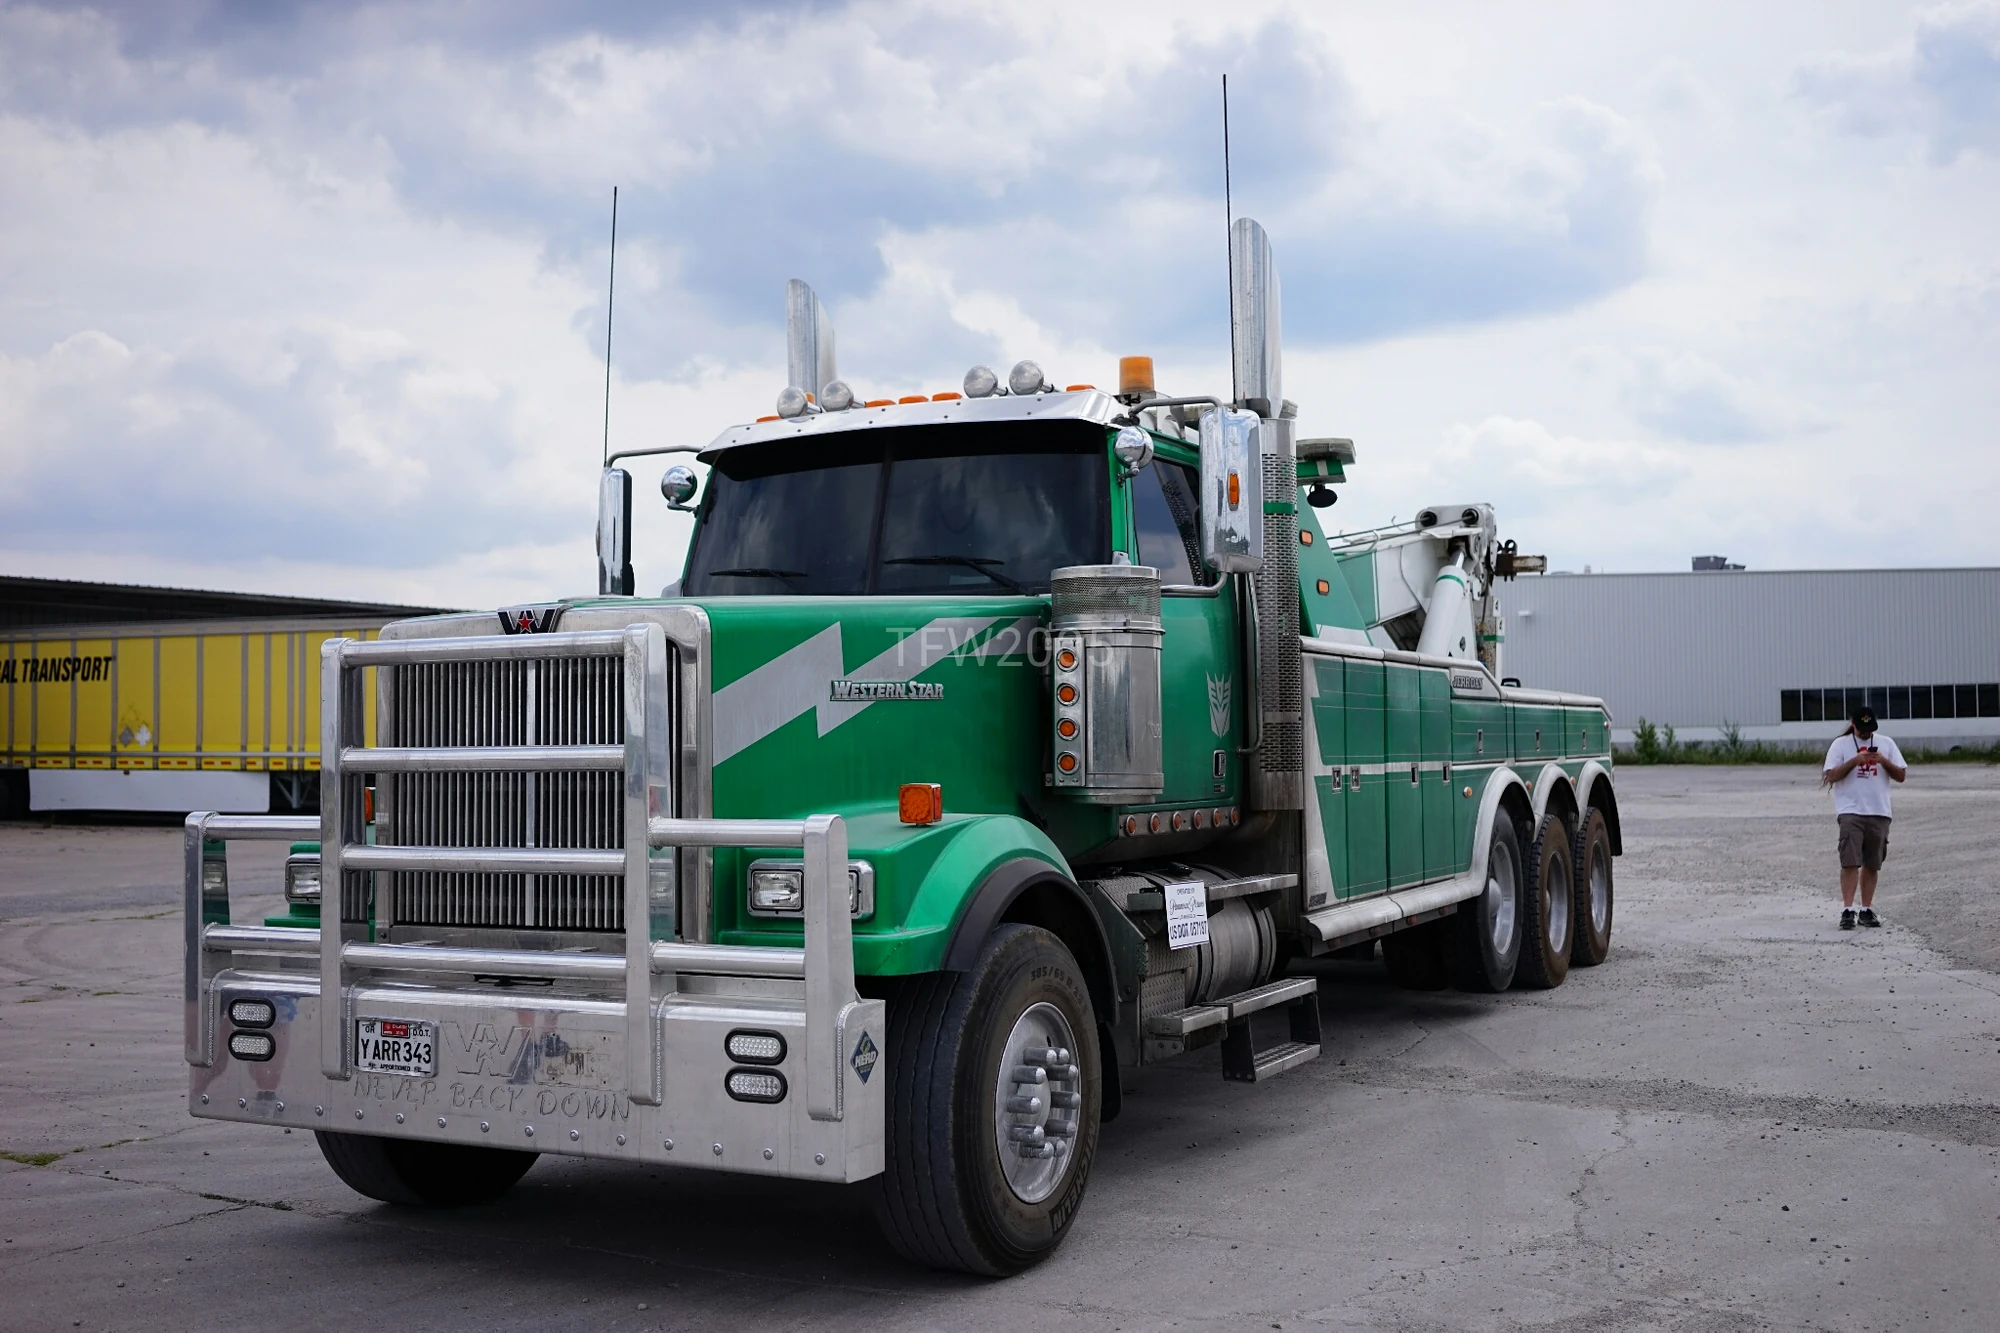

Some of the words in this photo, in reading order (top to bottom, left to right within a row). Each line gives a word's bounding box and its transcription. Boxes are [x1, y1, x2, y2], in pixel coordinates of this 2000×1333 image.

[0, 658, 18, 683] AL
[22, 656, 113, 682] TRANSPORT
[908, 681, 944, 698] STAR
[365, 1025, 375, 1033] OR
[353, 1075, 438, 1105] NEVER
[449, 1083, 527, 1115] BACK
[536, 1091, 630, 1122] DOWN
